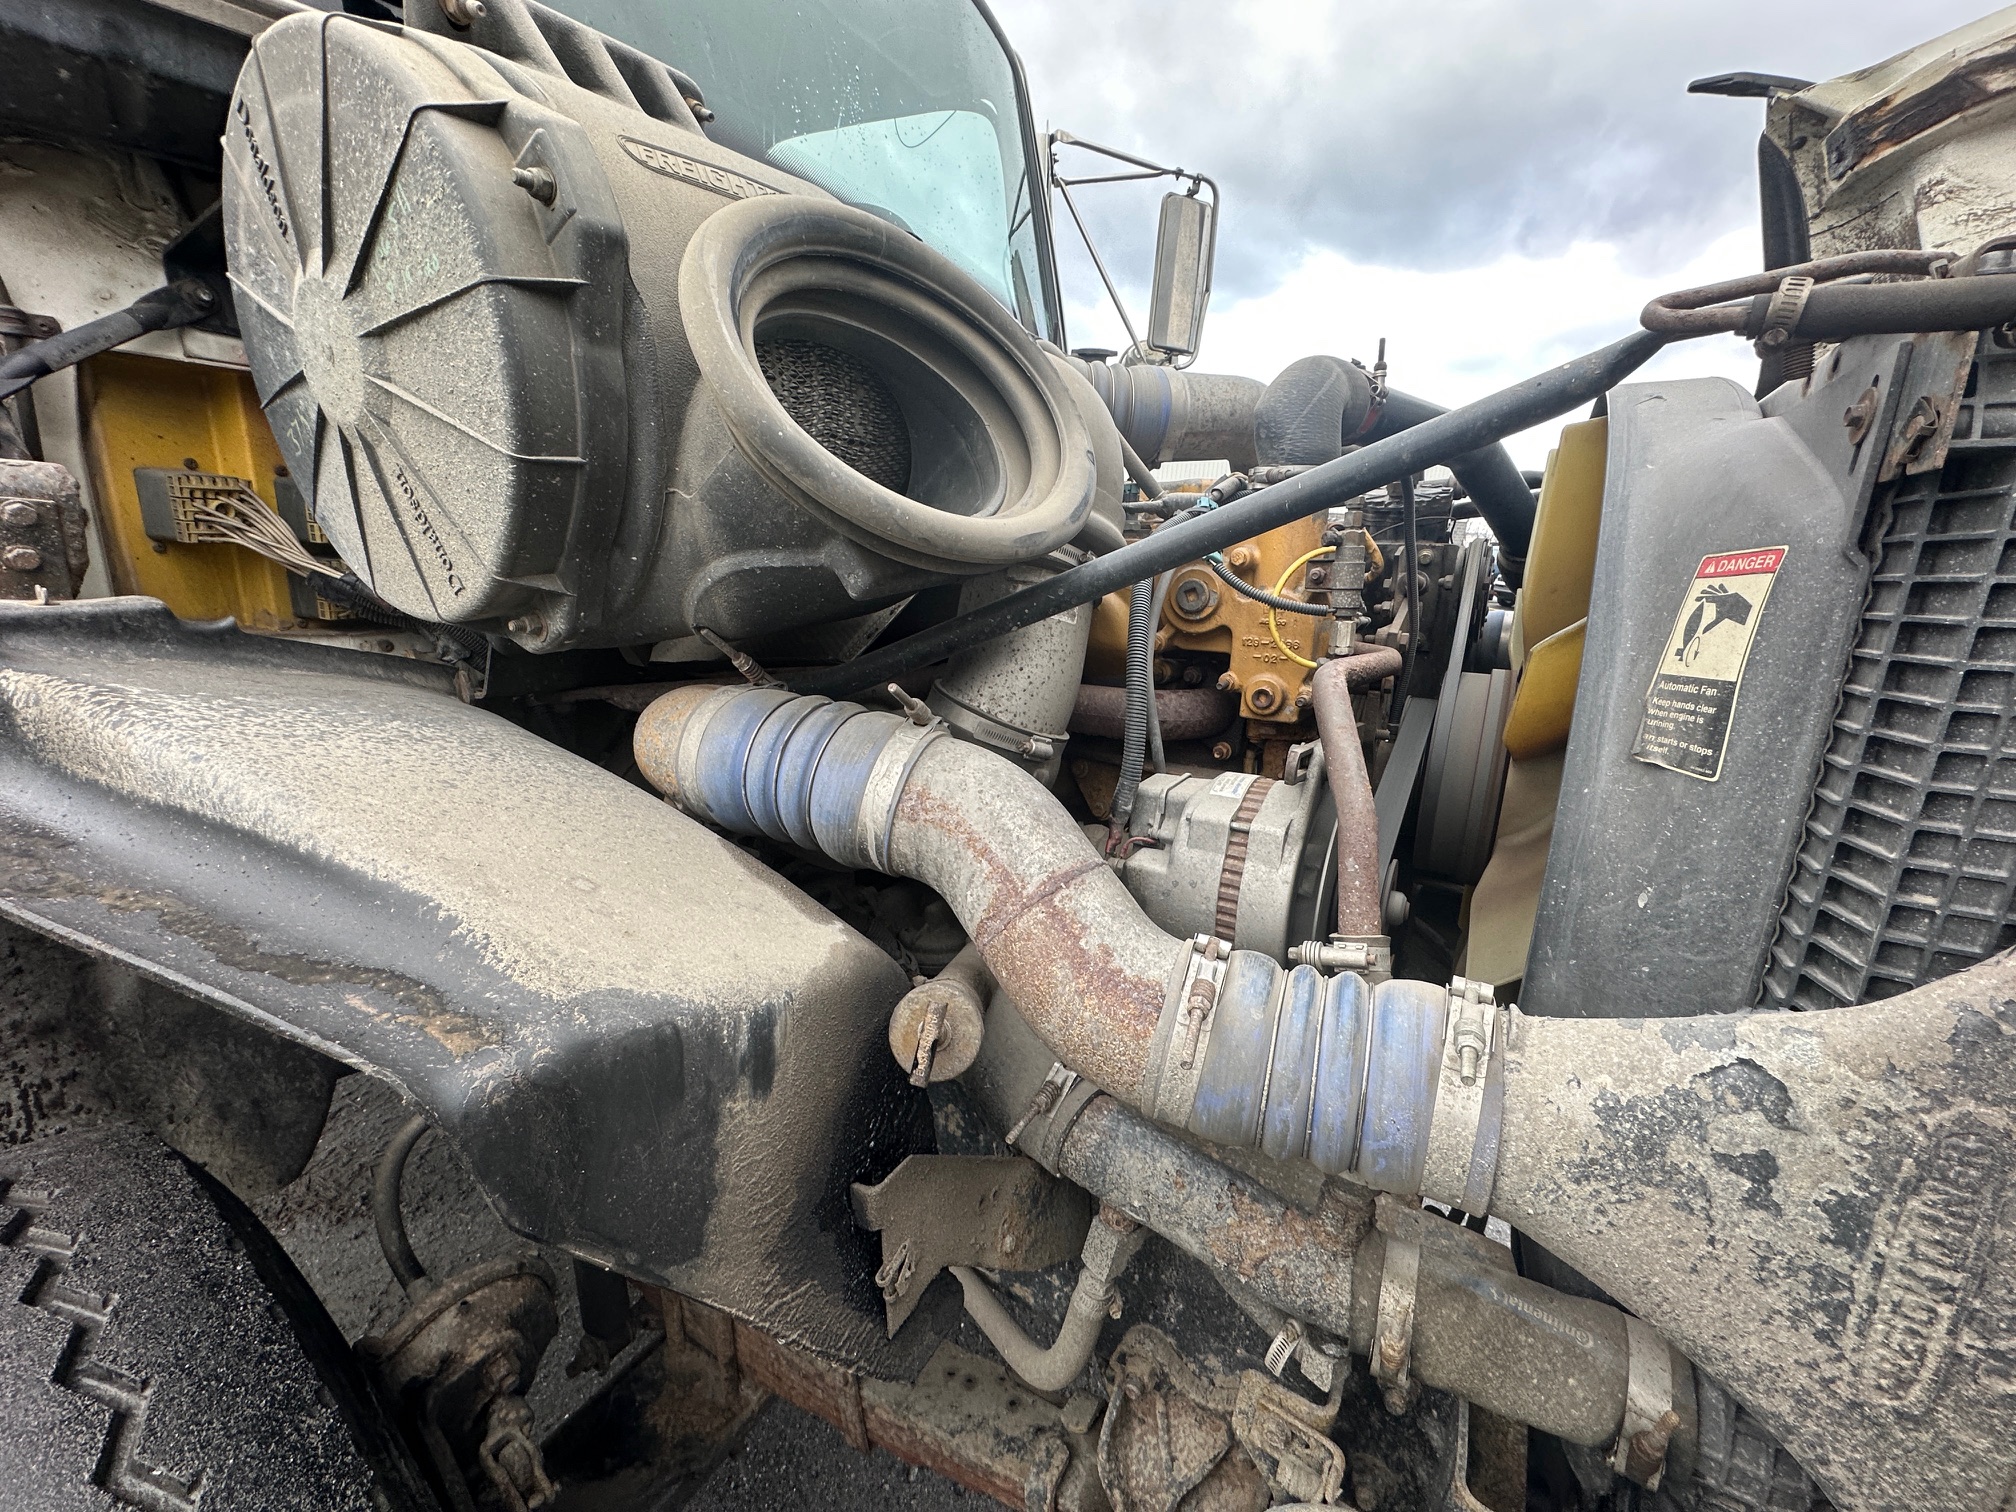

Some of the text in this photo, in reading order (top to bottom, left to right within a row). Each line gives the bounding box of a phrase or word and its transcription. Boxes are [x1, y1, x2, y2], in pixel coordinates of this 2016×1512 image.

[636, 143, 783, 199] FREIGHT
[396, 462, 466, 597] Donaldson
[1716, 554, 1776, 573] DANGER
[1658, 680, 1699, 695] Automatic
[1652, 696, 1717, 714] Keep hands clear
[1647, 708, 1705, 725] when engine is
[1656, 735, 1679, 747] starts
[1679, 741, 1689, 750] or
[1689, 744, 1714, 757] stops
